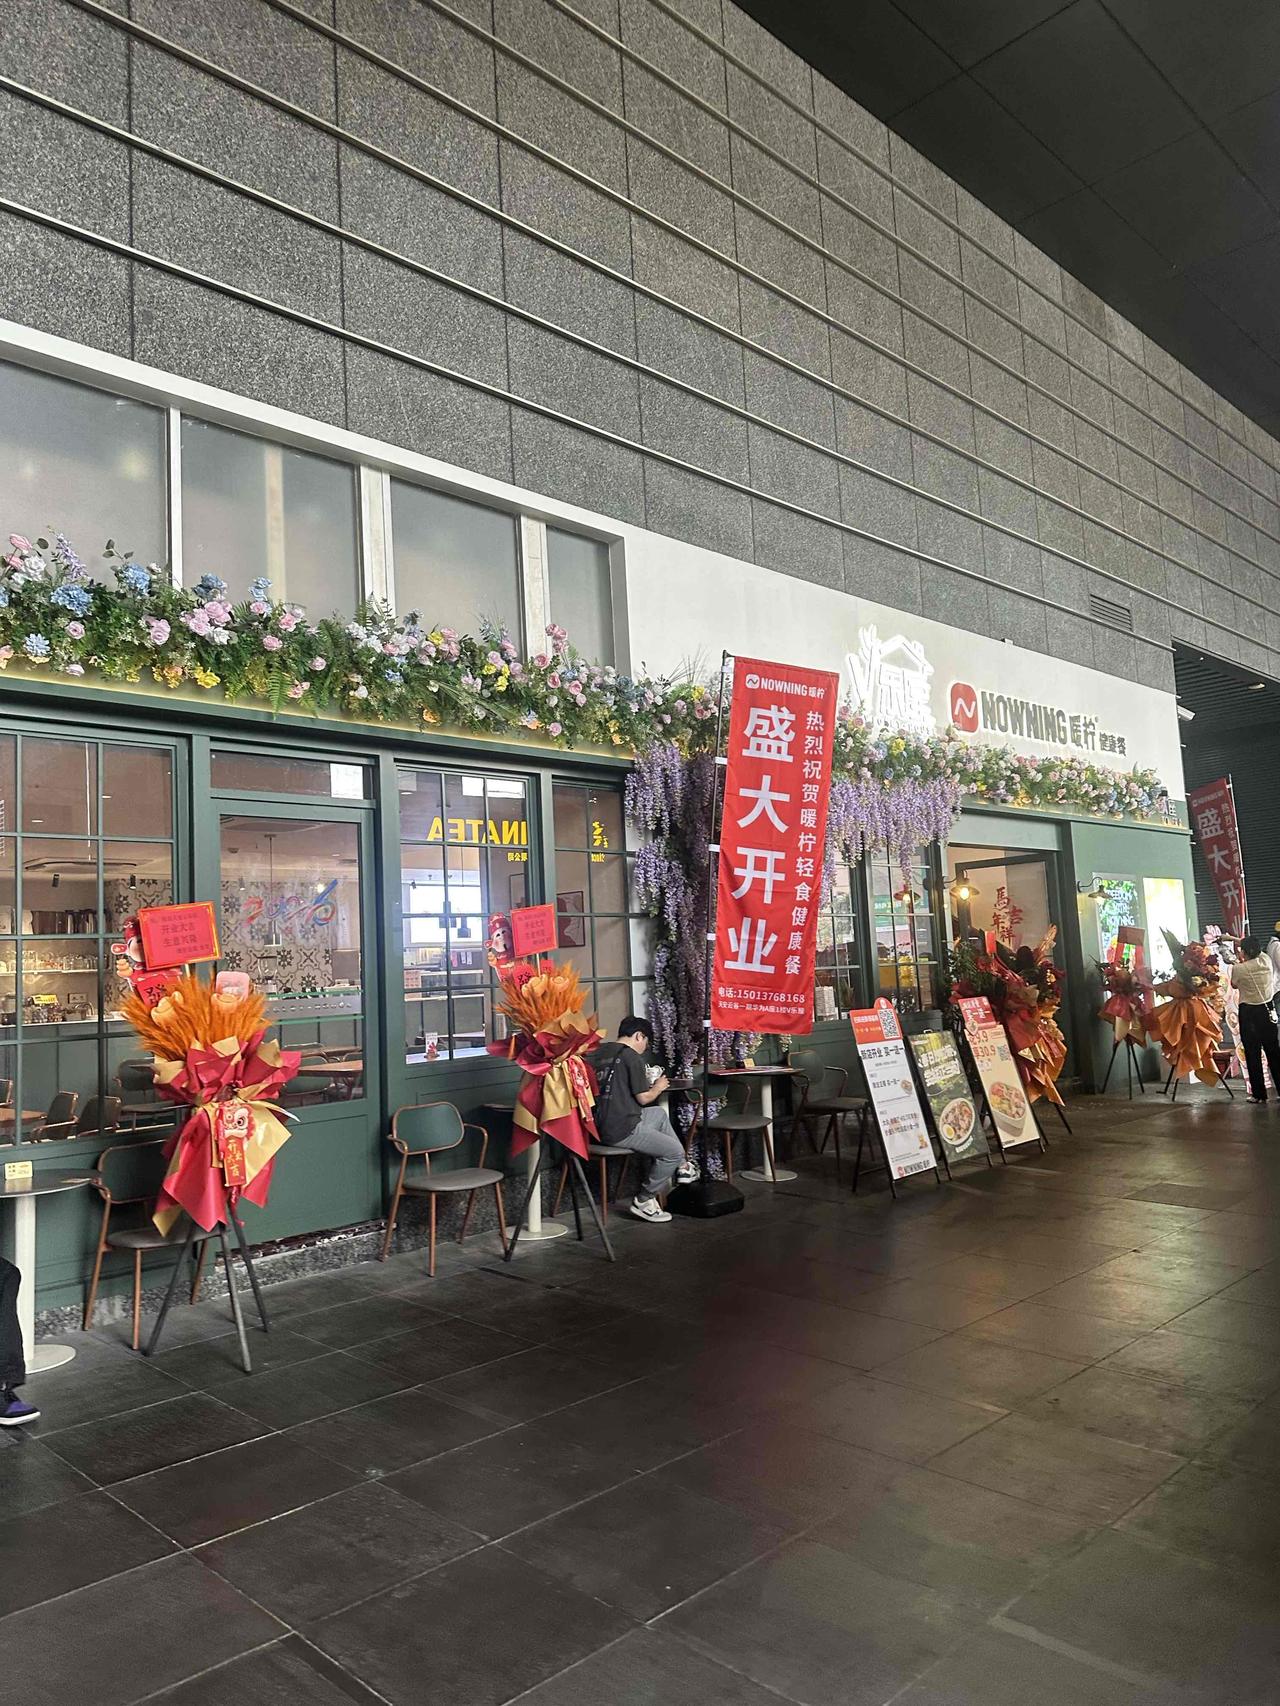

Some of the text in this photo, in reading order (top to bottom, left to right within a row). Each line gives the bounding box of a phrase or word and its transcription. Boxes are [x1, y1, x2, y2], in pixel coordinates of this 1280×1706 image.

[760, 677, 808, 697] NOWNING
[981, 691, 1068, 745] NOWNING
[724, 704, 796, 974] 盛大开业
[785, 711, 825, 975] 热烈祝贺暖柠轻食健康餐
[718, 986, 805, 1003] 电话:15013768168
